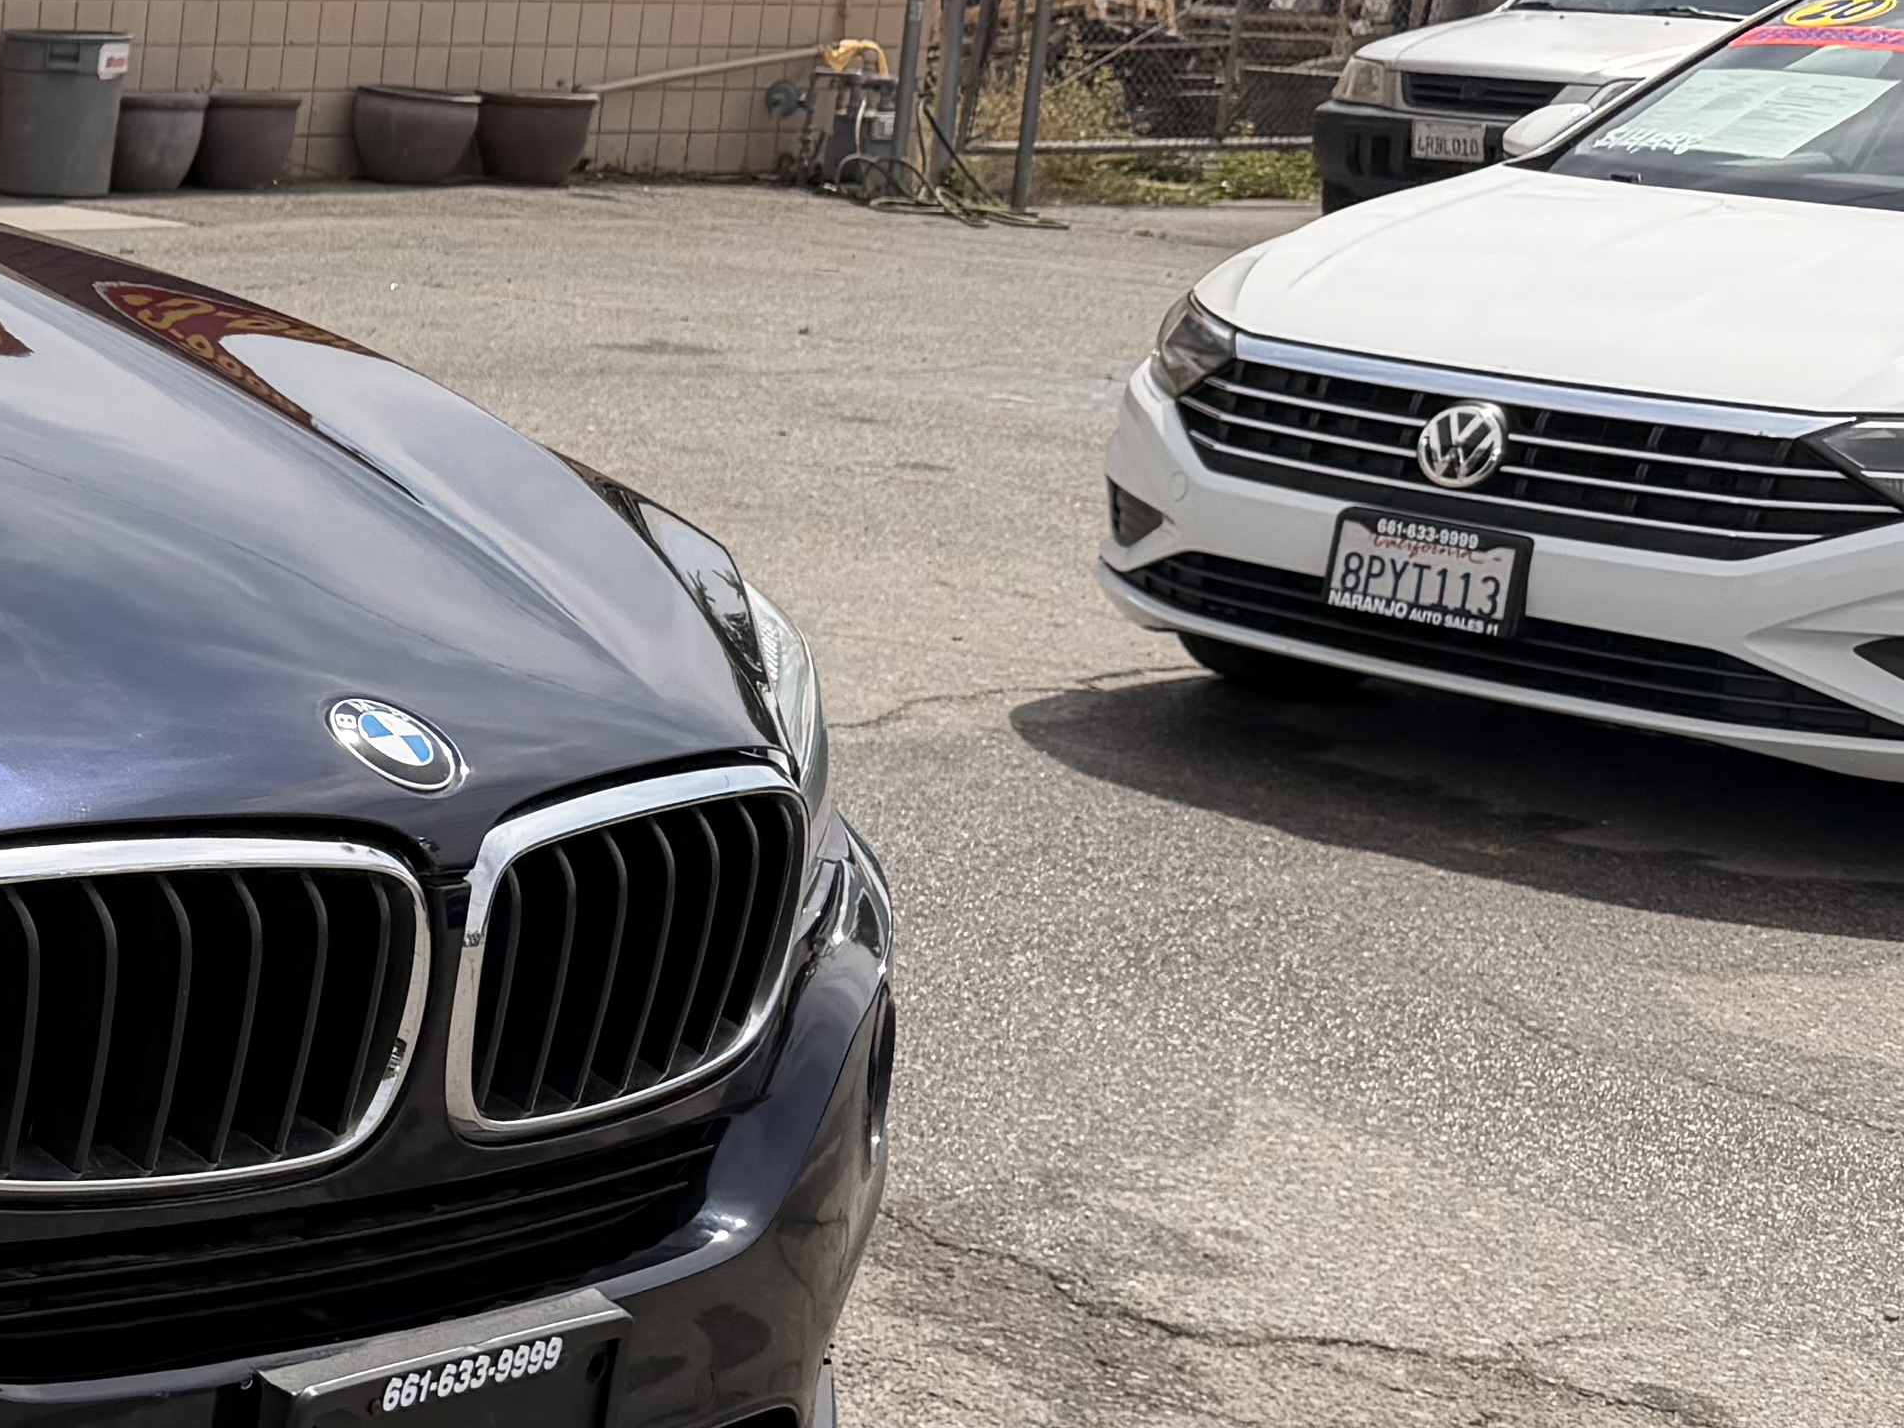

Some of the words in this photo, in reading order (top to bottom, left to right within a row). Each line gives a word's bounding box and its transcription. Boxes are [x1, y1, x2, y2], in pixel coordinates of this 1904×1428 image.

[1796, 0, 1887, 21] 20
[1377, 518, 1479, 549] 661-633-9999
[1340, 551, 1500, 618] 8PYT113
[1327, 590, 1408, 619] NARANJO
[1409, 607, 1442, 625] AUTO
[1444, 613, 1484, 635] SALES
[382, 1336, 563, 1412] 661-633-9999
